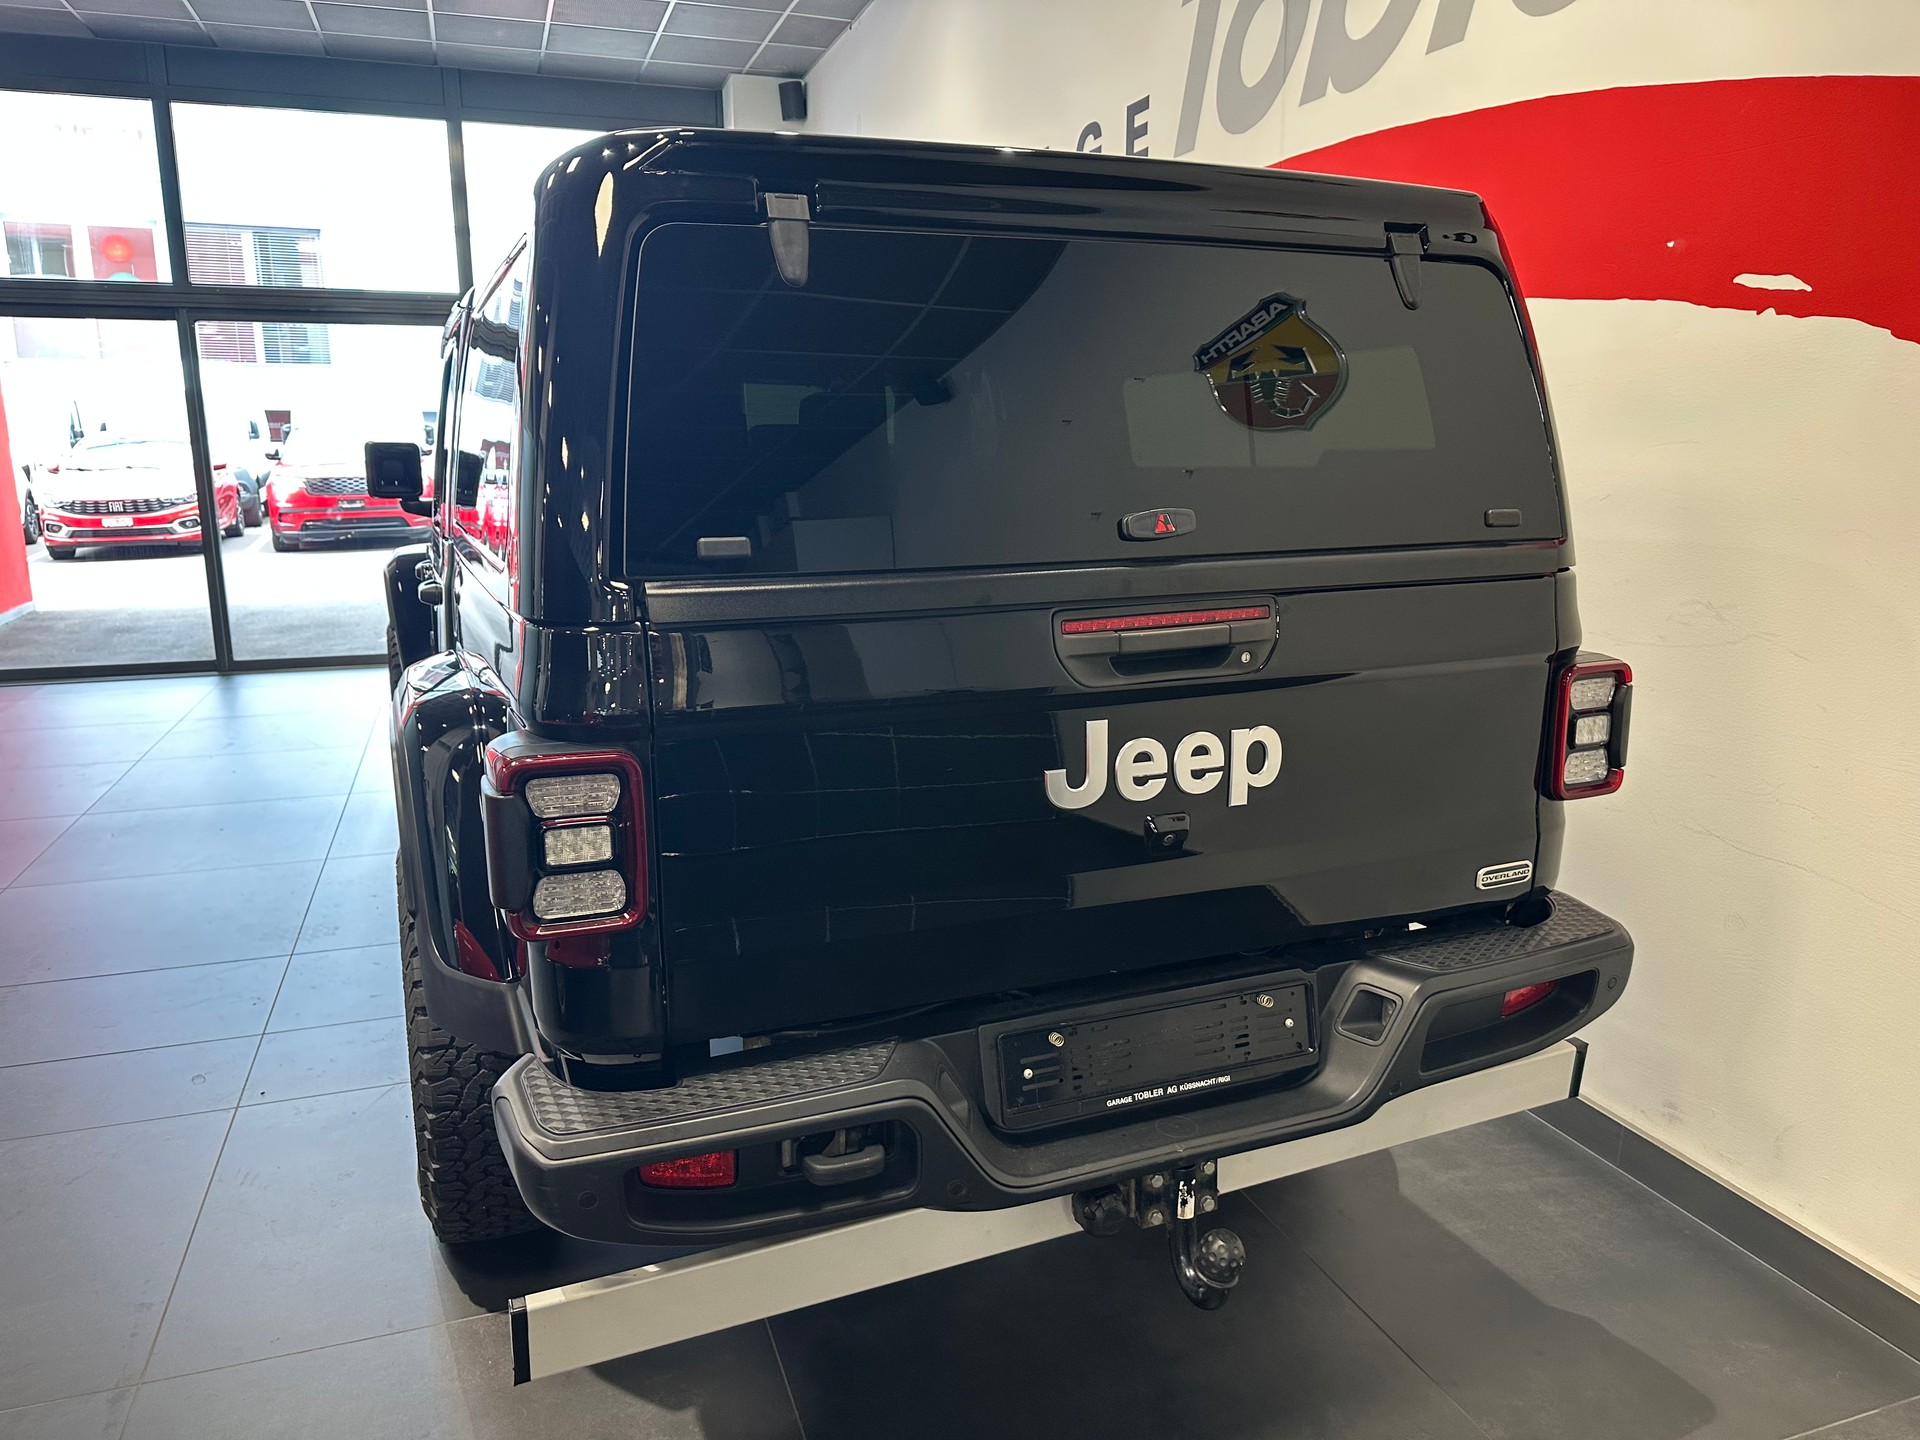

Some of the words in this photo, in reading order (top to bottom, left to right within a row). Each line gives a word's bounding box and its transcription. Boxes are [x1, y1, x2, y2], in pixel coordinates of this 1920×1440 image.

[108, 501, 124, 512] FIAT
[1044, 719, 1283, 809] Jeep
[1481, 869, 1530, 882] OVERLAND
[1106, 1095, 1133, 1107] GARAGE
[1133, 1088, 1164, 1101] TOBLER
[1166, 1085, 1178, 1095] AG
